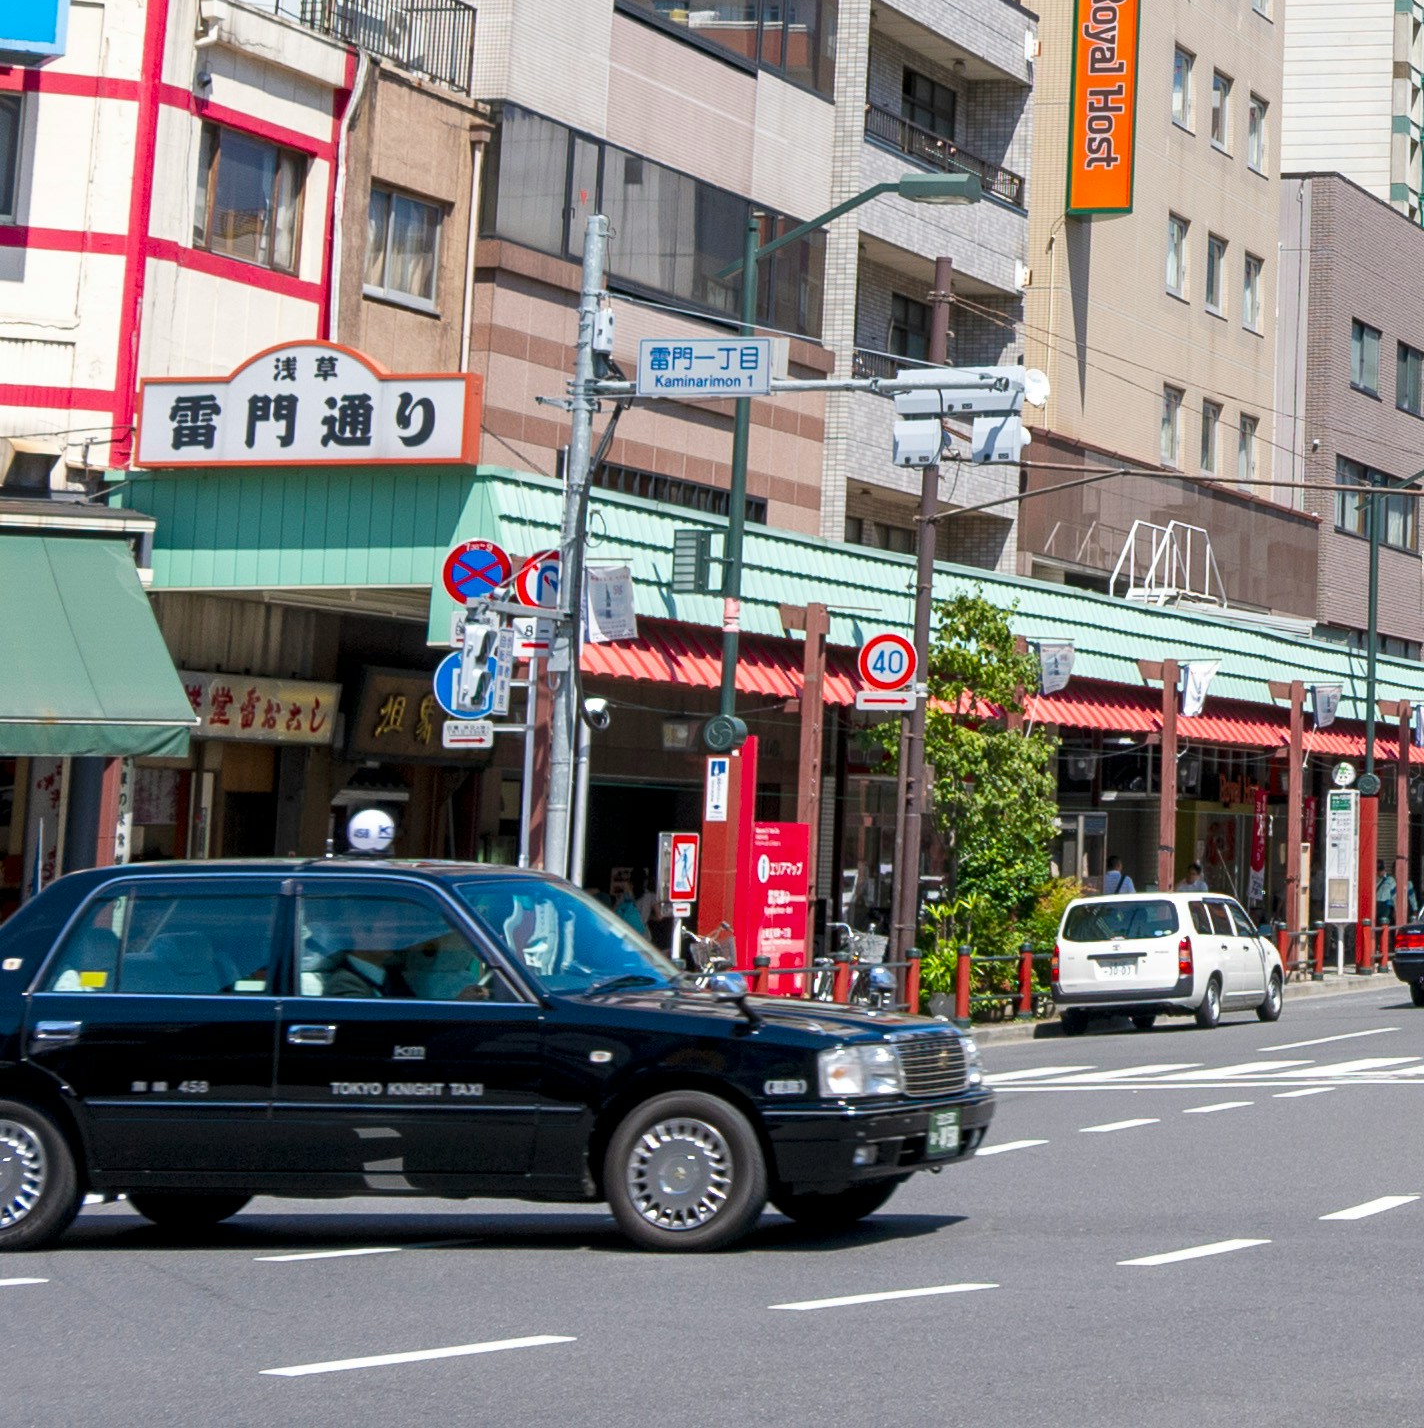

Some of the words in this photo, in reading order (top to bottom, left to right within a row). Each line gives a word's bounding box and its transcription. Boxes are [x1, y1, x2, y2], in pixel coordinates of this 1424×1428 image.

[1085, 84, 1126, 170] Host
[273, 355, 339, 383] 浅草
[649, 345, 760, 372] 雷門一丁目
[655, 374, 740, 389] Kaminarimon
[747, 375, 754, 388] 1
[169, 392, 437, 451] 雷門通り
[872, 650, 904, 675] 40
[178, 1081, 209, 1094] 458
[331, 1082, 382, 1096] TOKYO
[387, 1082, 443, 1097] KNIGHT
[450, 1083, 483, 1097] TAXI
